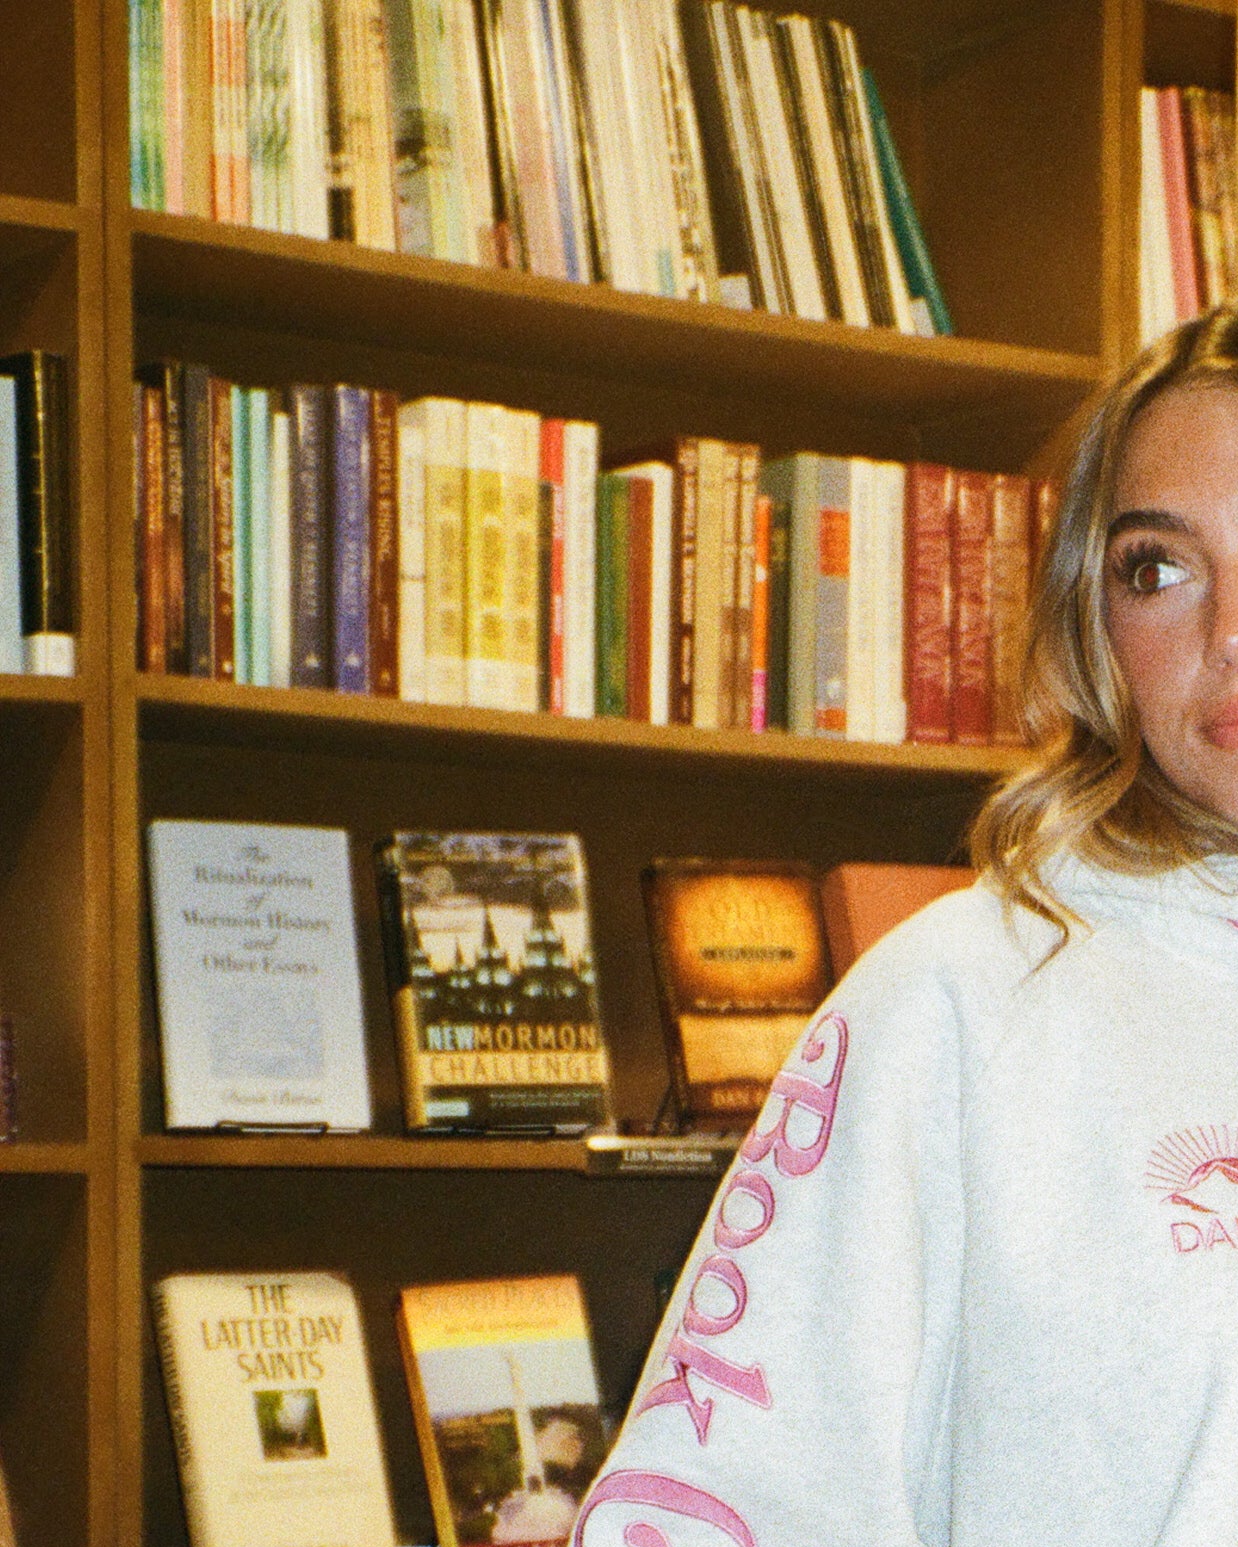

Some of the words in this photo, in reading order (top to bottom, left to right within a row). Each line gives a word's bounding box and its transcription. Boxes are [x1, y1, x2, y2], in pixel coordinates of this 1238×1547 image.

[426, 1023, 474, 1050] NEW
[473, 1022, 598, 1050] MORMON
[634, 1009, 850, 1447] Book
[246, 1283, 292, 1315] THE
[199, 1315, 346, 1352] LATTER-DAY
[236, 1349, 326, 1384] SAINTS
